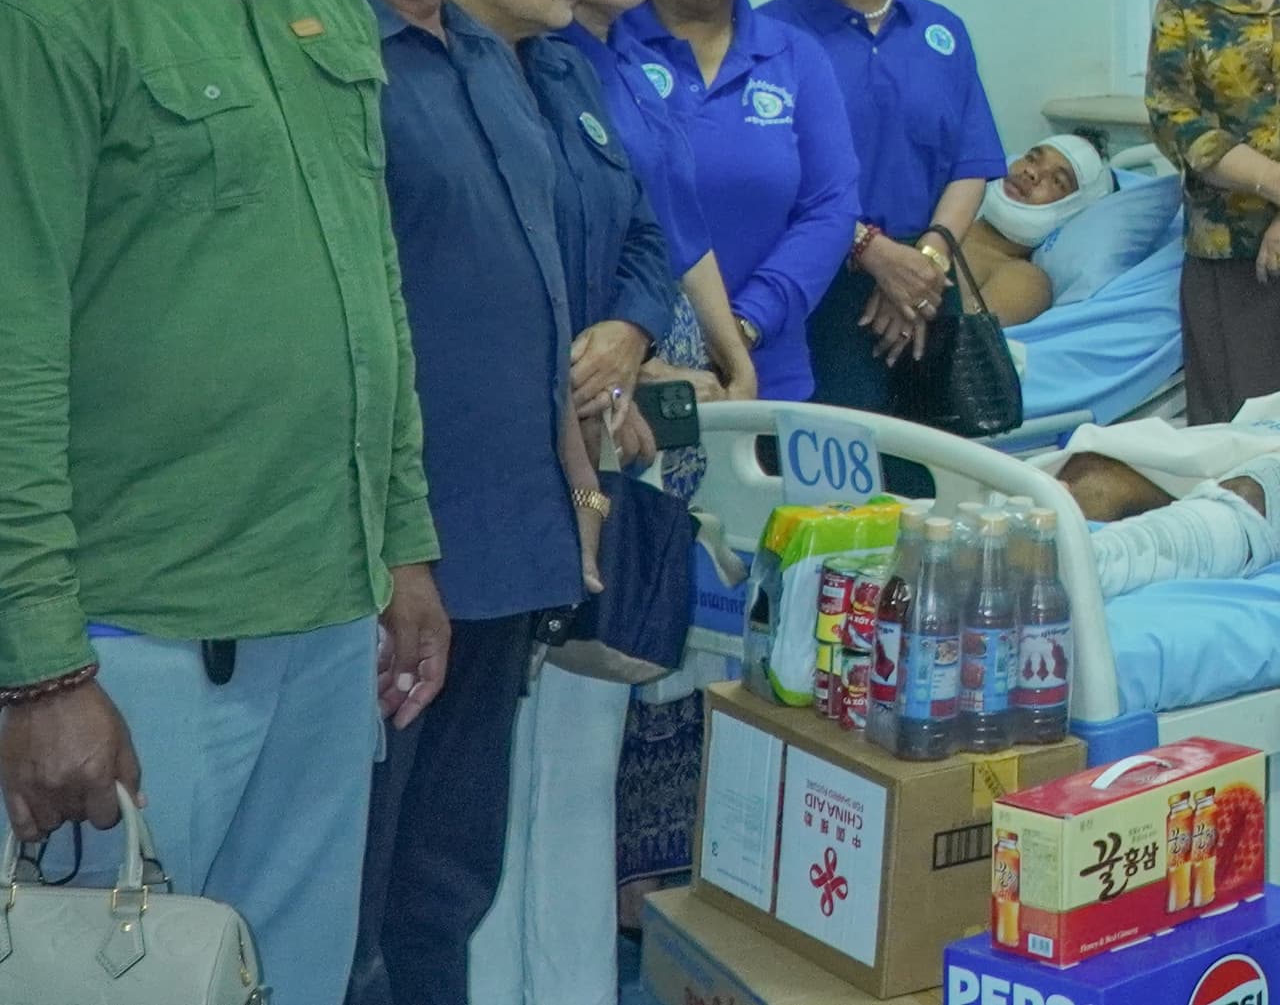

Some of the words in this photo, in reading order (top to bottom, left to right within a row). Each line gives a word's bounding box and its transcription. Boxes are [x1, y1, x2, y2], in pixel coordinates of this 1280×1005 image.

[787, 428, 874, 494] C08
[804, 792, 826, 813] AID
[827, 801, 863, 830] CHINA
